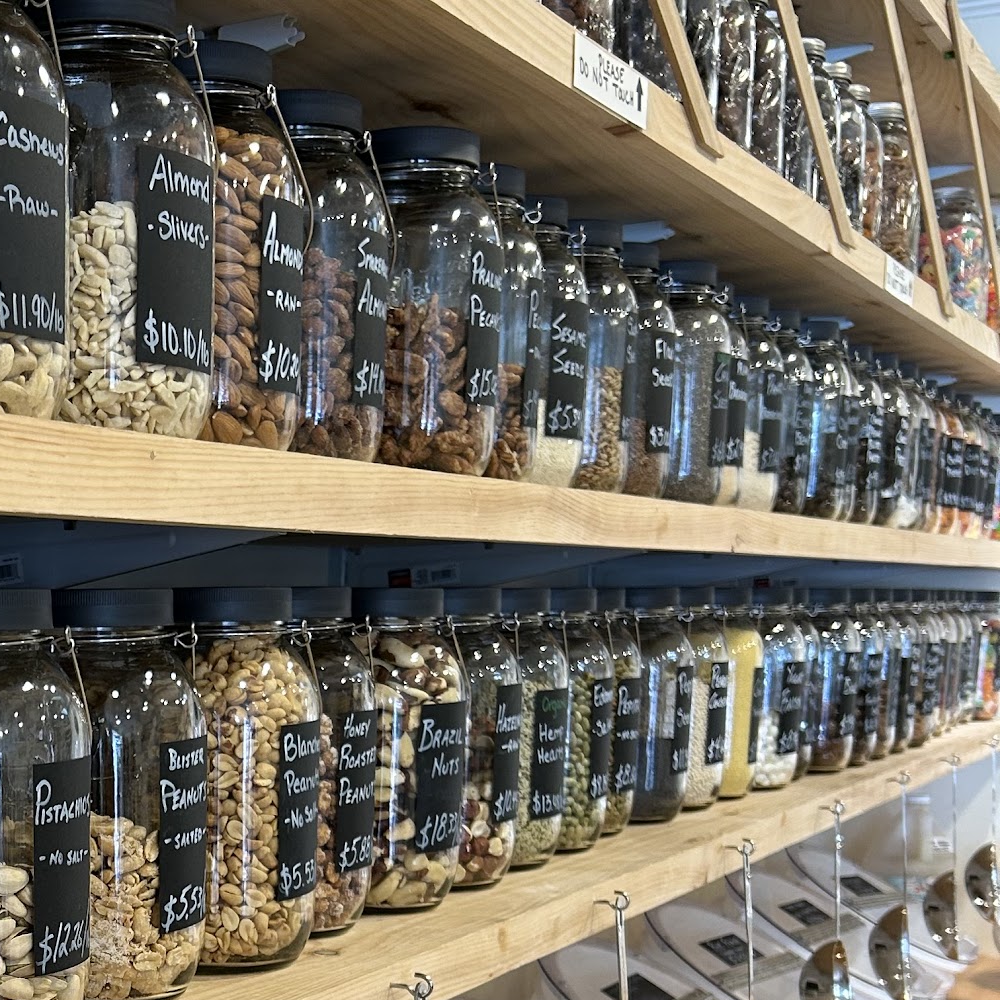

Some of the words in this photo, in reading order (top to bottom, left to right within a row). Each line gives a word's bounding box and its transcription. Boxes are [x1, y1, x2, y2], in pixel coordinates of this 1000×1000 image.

[579, 56, 589, 79] DO
[592, 66, 609, 92] NOT
[598, 53, 625, 85] PLEASE
[149, 153, 210, 205] Almond
[143, 308, 210, 367] $10.10/lb
